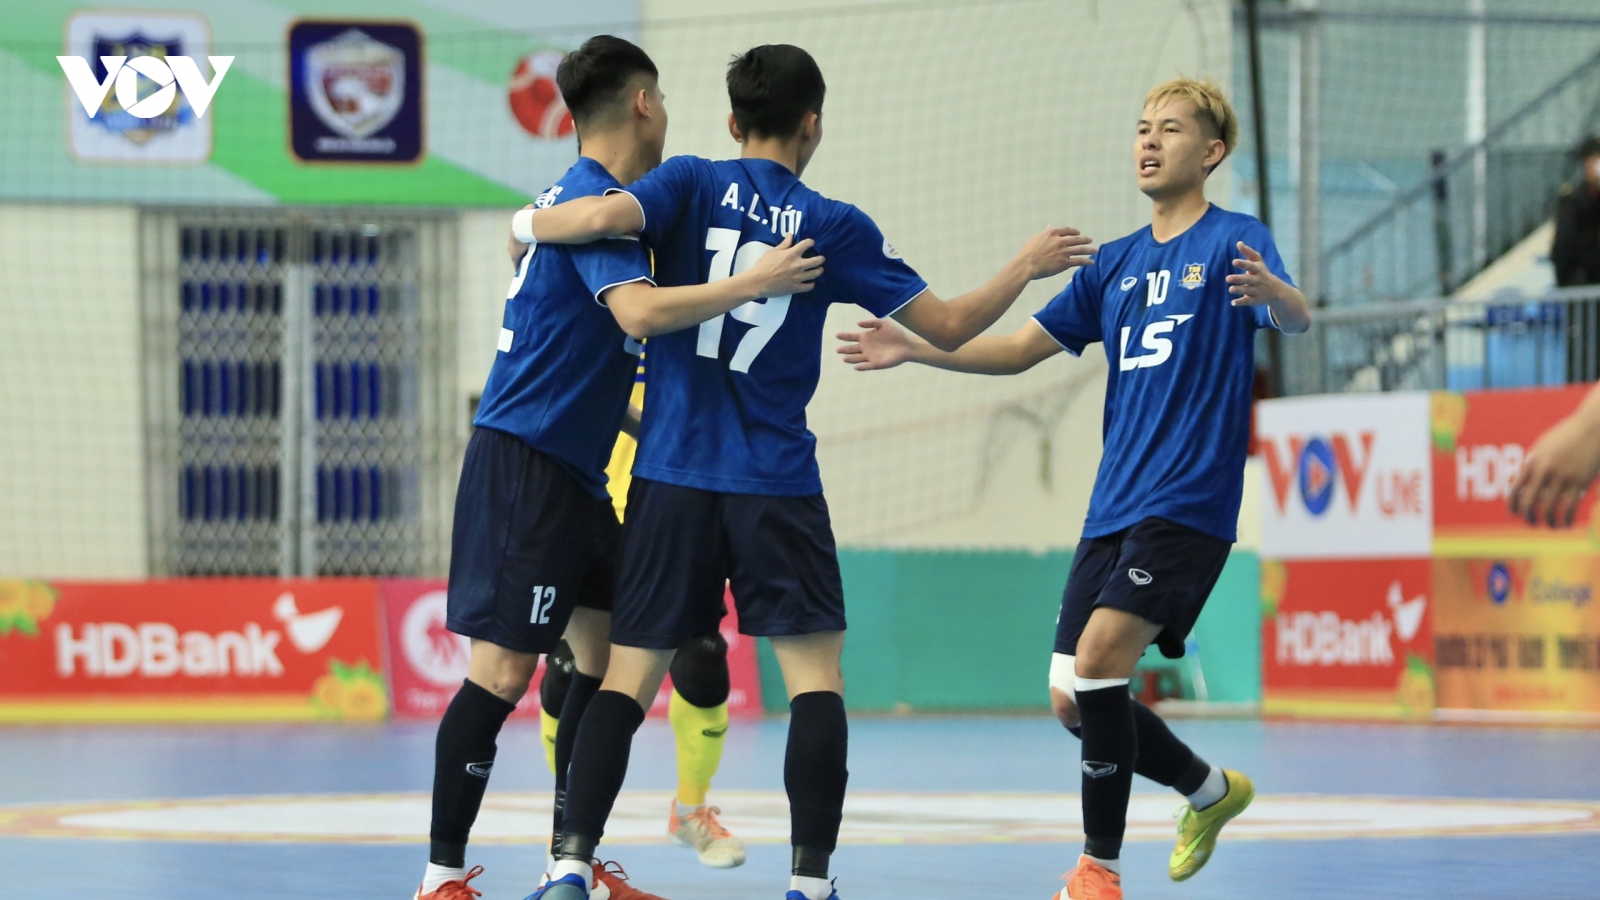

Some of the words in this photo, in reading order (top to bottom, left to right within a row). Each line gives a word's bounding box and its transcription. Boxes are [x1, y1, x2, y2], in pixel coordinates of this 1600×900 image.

[696, 227, 793, 374] 19
[1146, 269, 1171, 307] 10
[1119, 315, 1188, 372] LS
[1261, 430, 1375, 518] VOV
[1456, 443, 1528, 501] HDB
[529, 585, 556, 624] 12
[55, 621, 285, 678] HDBank
[1275, 610, 1394, 667] HDBank
